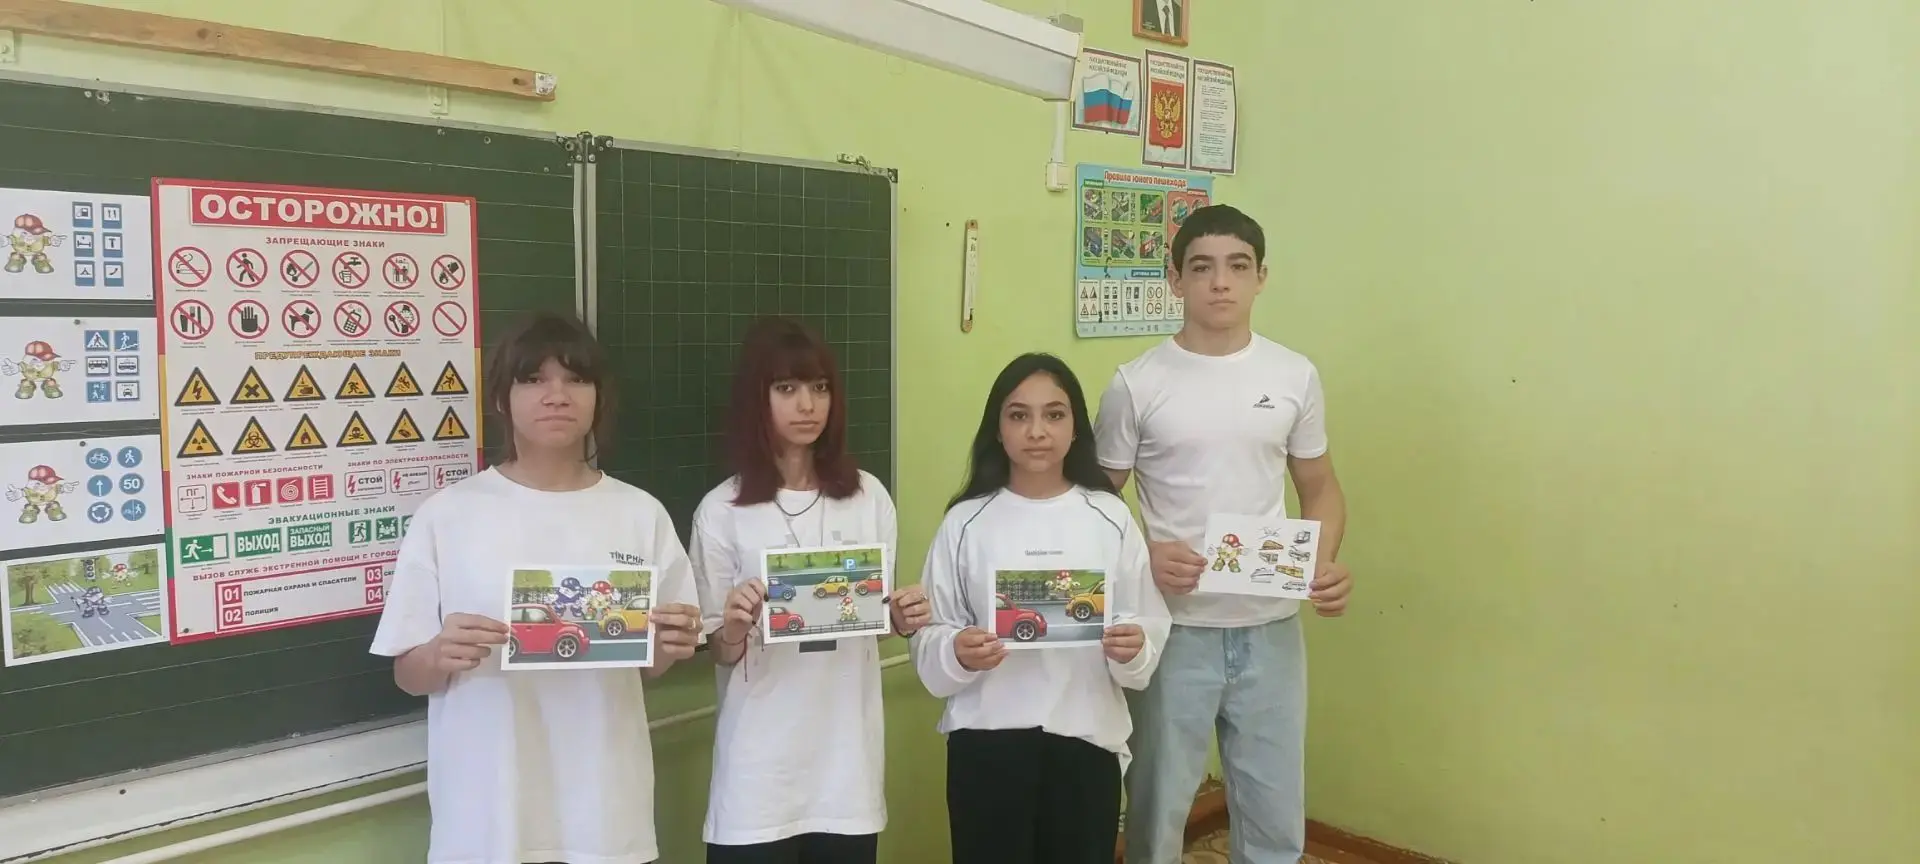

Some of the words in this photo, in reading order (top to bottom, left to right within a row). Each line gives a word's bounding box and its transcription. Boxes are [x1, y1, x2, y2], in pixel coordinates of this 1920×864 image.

[1104, 171, 1131, 183] Правила
[1132, 175, 1152, 185] юного
[200, 194, 438, 229] ОСТОРОЖНО!
[265, 237, 349, 247] ЗАПРЕЩАЮЩИЕ
[353, 240, 385, 248] ЗНАКИ
[254, 350, 366, 360] ПРЕДУПРЕЖДАЮЩИЕ
[368, 349, 401, 357] ЗНАКИ
[216, 469, 260, 478] ПОЖАРНОЙ
[263, 464, 323, 475] БЕЗОПАСНОСТИ
[445, 468, 469, 477] СТОЙ
[123, 478, 140, 490] 50
[358, 476, 383, 485] СТОЙ
[186, 488, 199, 497] ПГ
[268, 509, 360, 524] ЭВАКУАЦИОННЫЕ
[363, 505, 395, 515] ЗНАКИ
[290, 525, 330, 535] ЗАПАСНЫЙ
[237, 532, 280, 552] ВЫХОД
[290, 532, 331, 548] ВЫХОД
[193, 572, 225, 581] ВЫЗОВ
[228, 568, 260, 577] СЛУЖБ
[263, 560, 320, 573] ЭКСТРЕННОЙ
[322, 554, 360, 564] ПОМОЩИ
[846, 559, 855, 569] P
[367, 568, 381, 581] 03
[243, 586, 282, 597] ПОЖАРНАЯ
[319, 576, 357, 586] СПАСАТЕЛИ
[224, 588, 240, 601] 01
[367, 588, 382, 601] 04
[225, 608, 241, 622] 02
[245, 607, 279, 616] ПОЛИЦИЯ
